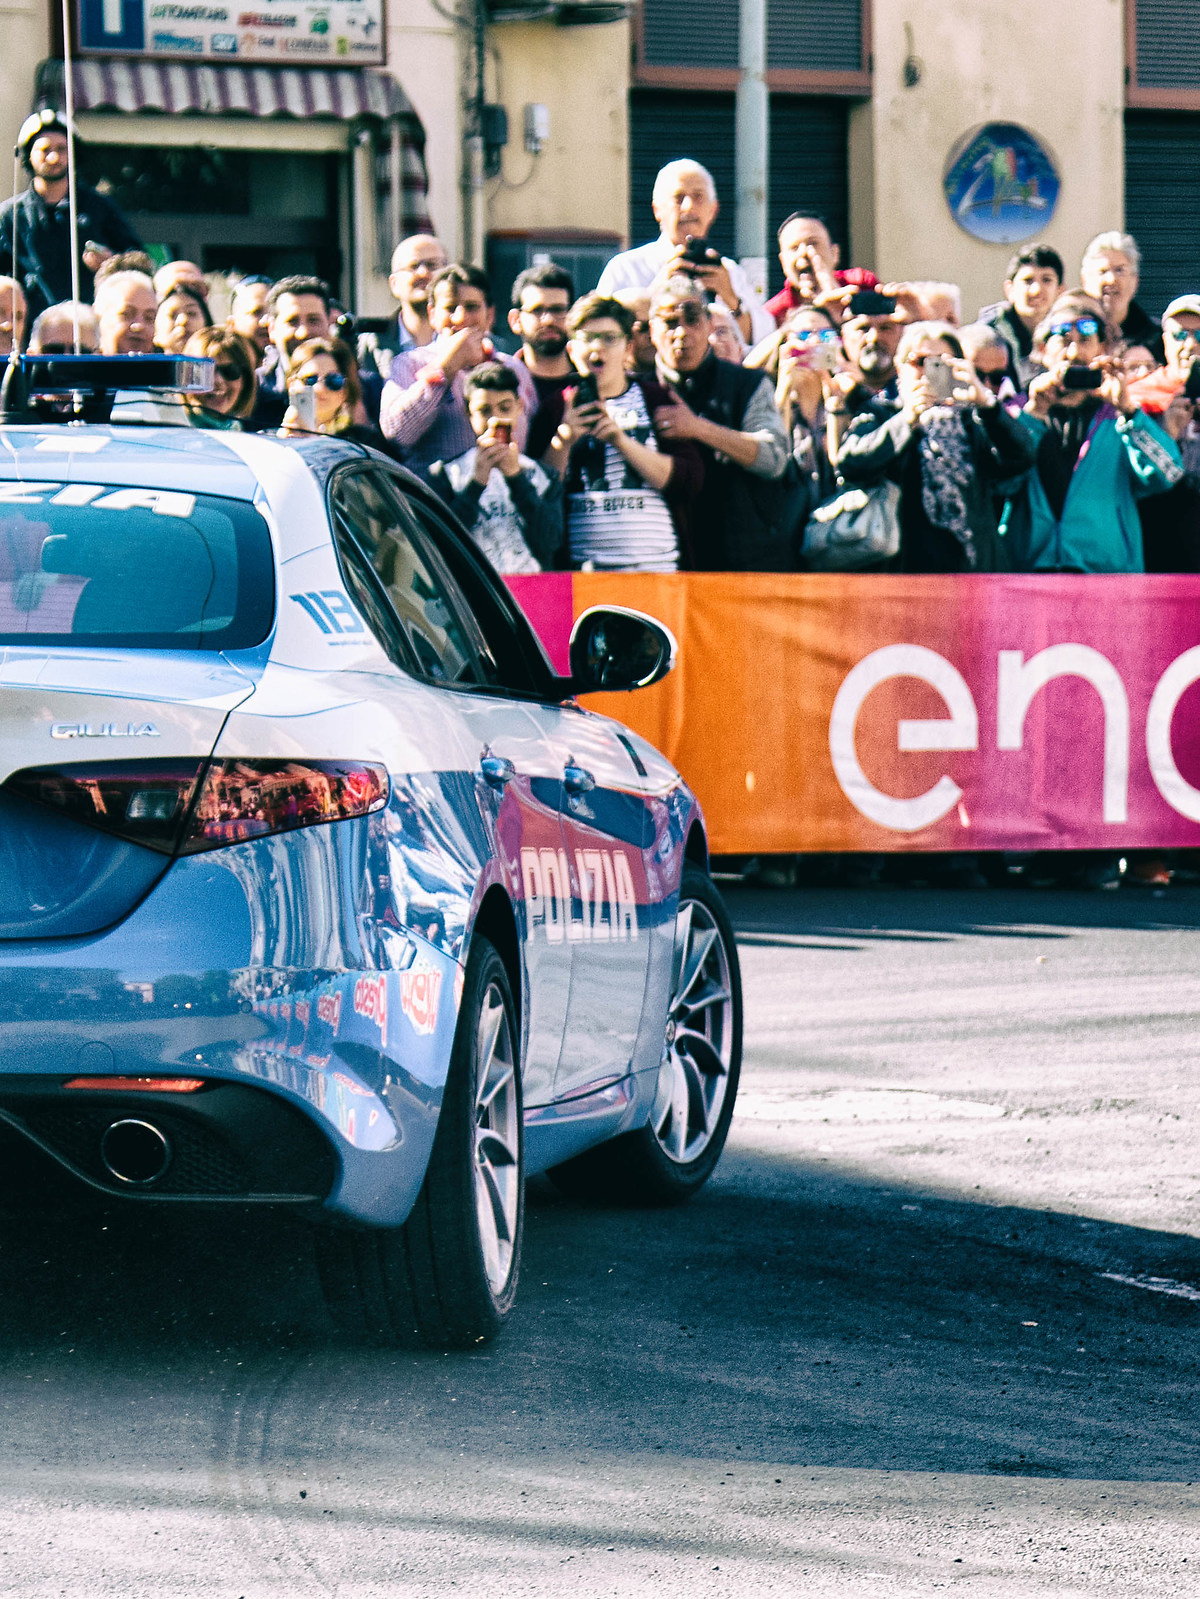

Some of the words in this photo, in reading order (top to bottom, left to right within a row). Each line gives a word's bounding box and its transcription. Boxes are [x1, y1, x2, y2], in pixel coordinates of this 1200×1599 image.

[288, 590, 365, 634] 113
[50, 722, 161, 740] GIULIA
[520, 847, 639, 945] POLIZIA
